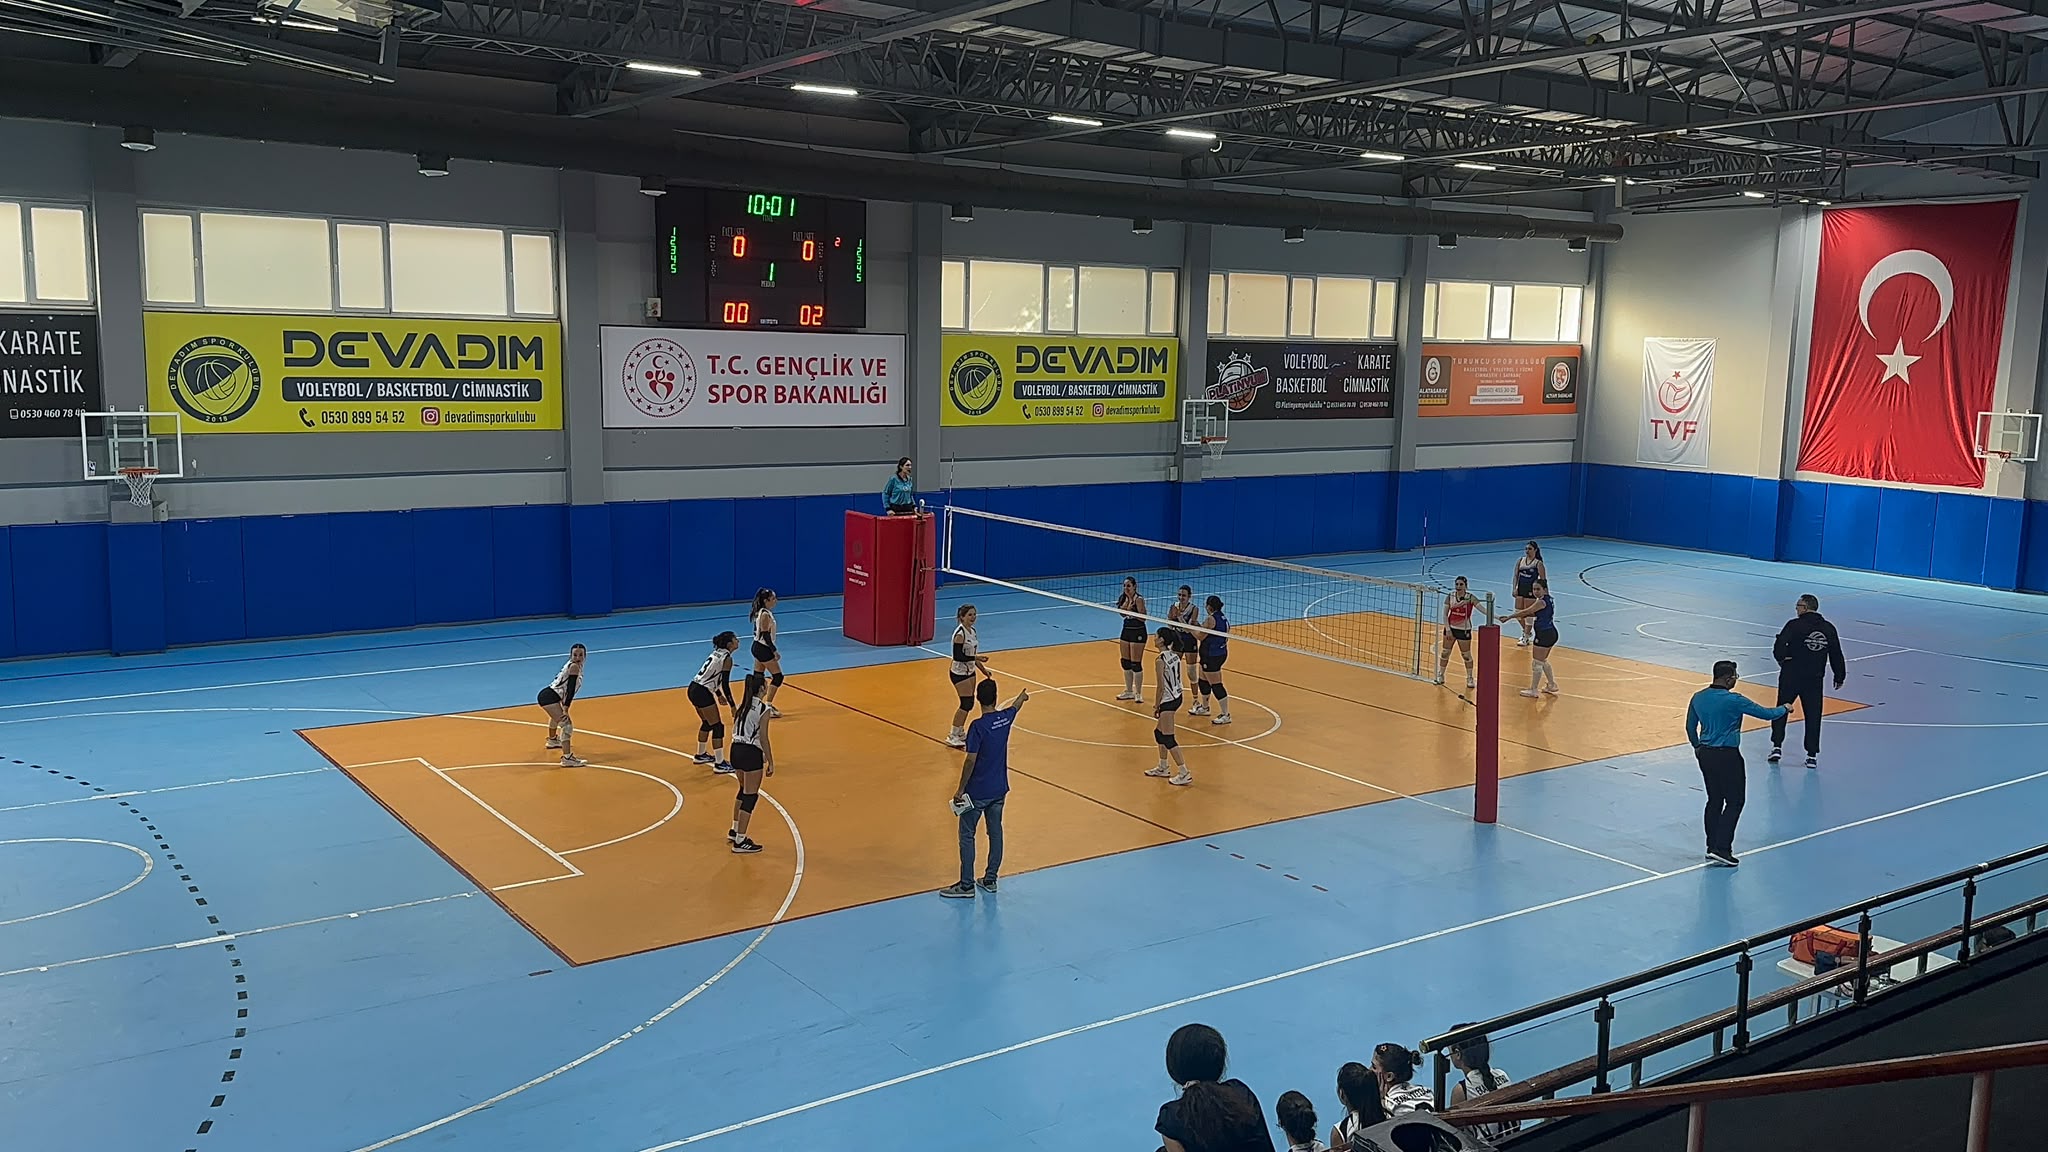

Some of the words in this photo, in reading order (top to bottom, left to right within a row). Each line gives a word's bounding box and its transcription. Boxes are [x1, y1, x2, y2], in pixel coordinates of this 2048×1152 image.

[748, 194, 795, 217] 10:01
[733, 235, 746, 257] 0
[802, 240, 814, 261] 0
[834, 236, 841, 247] 2
[769, 262, 774, 281] 1
[723, 302, 749, 323] 00
[799, 305, 823, 325] 02
[202, 338, 235, 349] SPOR
[282, 330, 544, 371] DEVADIM
[706, 354, 749, 376] T.C.
[755, 353, 854, 381] GENÇLİK
[860, 357, 887, 377] VE
[1015, 345, 1168, 374] DEVADIM
[1283, 353, 1329, 370] VOLEYBOL
[1357, 354, 1391, 370] KARATE
[1452, 357, 1490, 365] TURUNCU
[0, 365, 85, 394] NASTİK
[1276, 377, 1328, 394] BASKETBOL
[296, 382, 364, 398] VOLEYBOL
[377, 382, 450, 398] BASKETBOL
[462, 381, 530, 398] CİMNASTİK
[707, 383, 768, 404] SPOR
[773, 381, 887, 405] BAKANLIĞI
[1022, 383, 1061, 397] VOLEYBOL
[1068, 383, 1112, 397] BASKETBOL
[20, 409, 43, 419] 0530
[44, 409, 61, 418] 460
[62, 409, 74, 418] 78
[321, 410, 348, 424] 0530
[351, 410, 373, 424] 899
[375, 410, 389, 424] 54
[392, 410, 405, 424] 52
[444, 411, 536, 425] devadimsporkulubu
[1034, 406, 1051, 417] 0530
[1650, 418, 1698, 441] TVF
